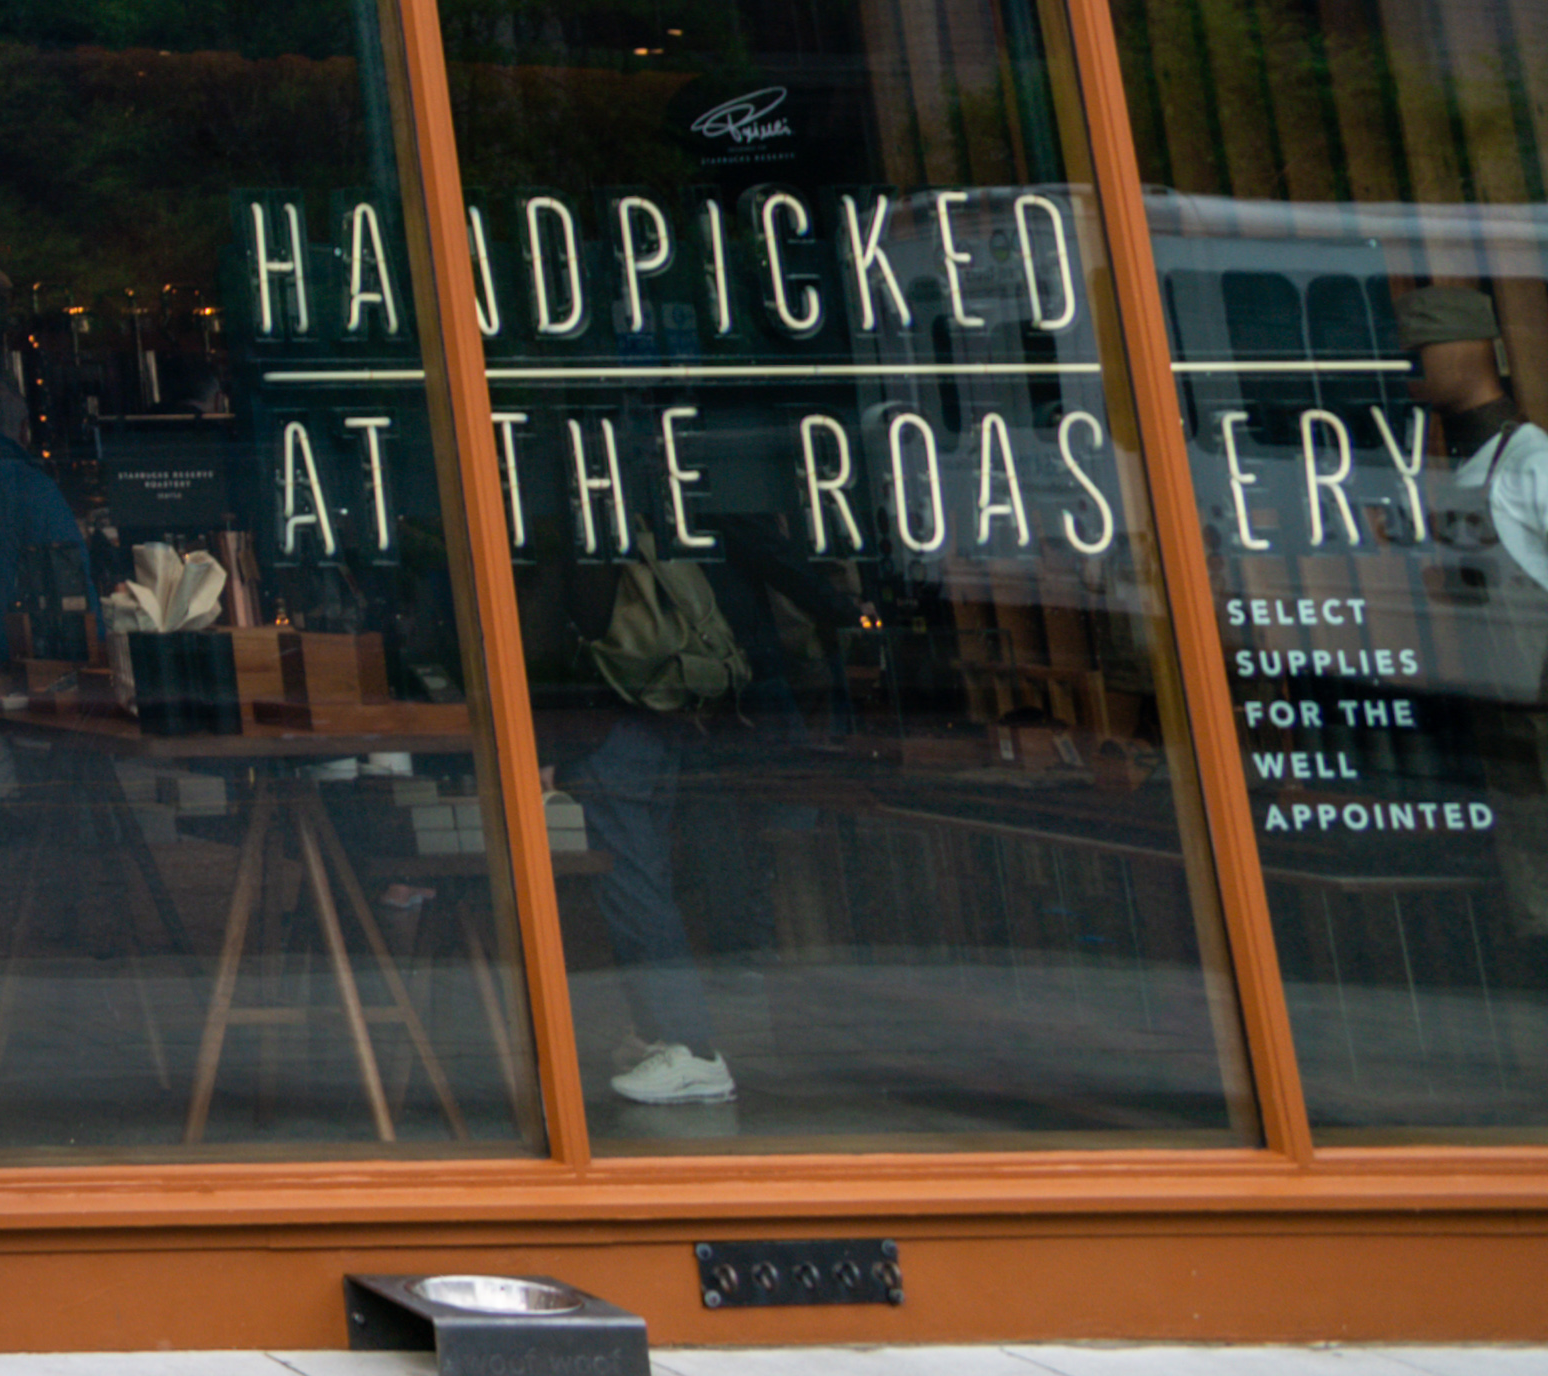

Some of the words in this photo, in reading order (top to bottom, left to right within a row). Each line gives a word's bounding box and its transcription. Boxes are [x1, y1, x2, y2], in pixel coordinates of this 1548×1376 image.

[283, 414, 392, 556] AT
[490, 406, 717, 555] THE
[800, 405, 1426, 554] ROASERY
[1226, 598, 1366, 626] SELECT
[1235, 648, 1419, 677] SUPPLIES
[1245, 700, 1322, 728] FOR
[1339, 700, 1415, 727] THE
[1253, 752, 1359, 780] WELL
[1265, 802, 1494, 831] APPOINTED
